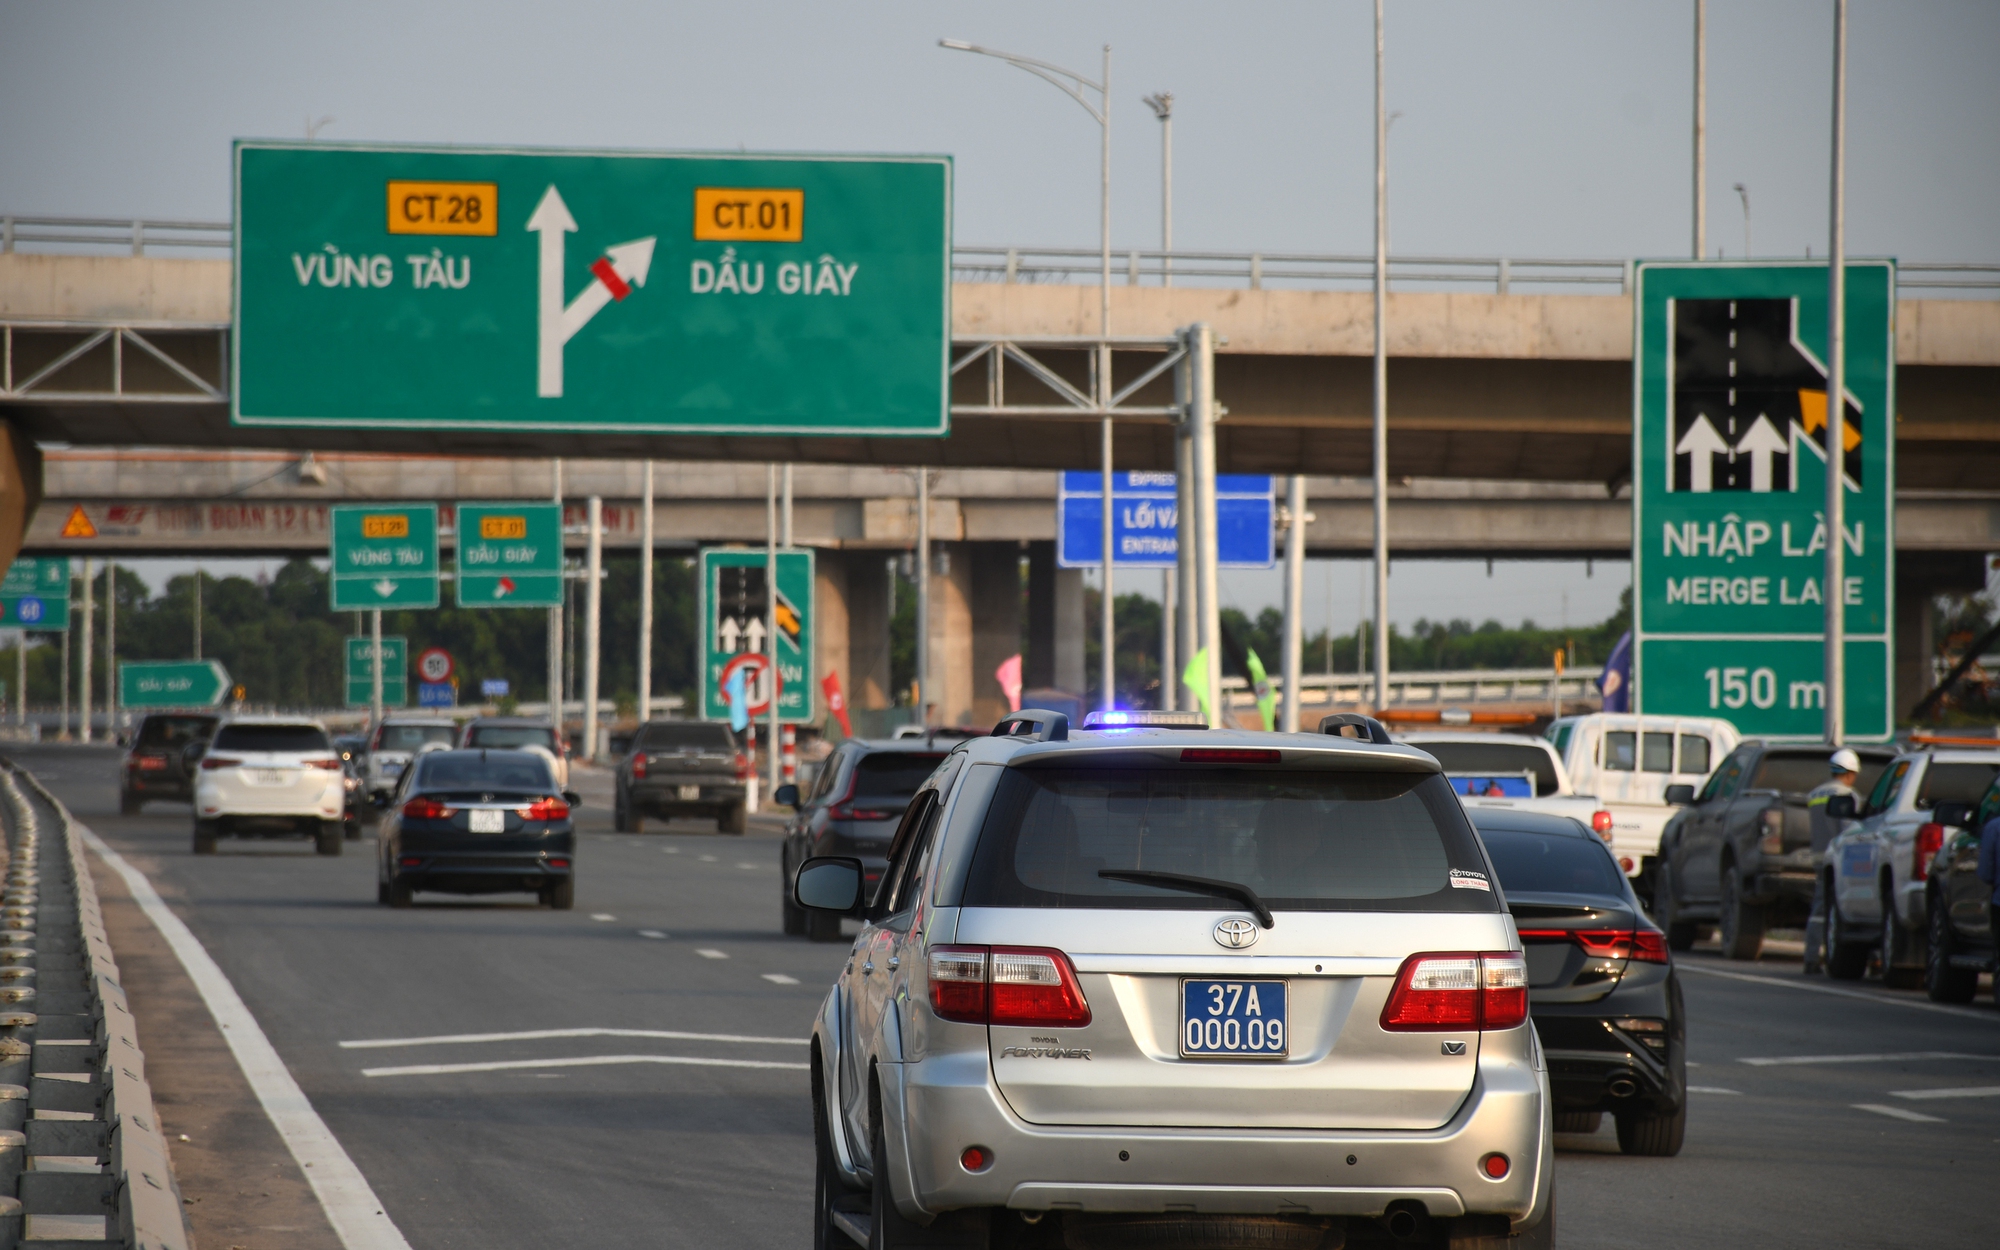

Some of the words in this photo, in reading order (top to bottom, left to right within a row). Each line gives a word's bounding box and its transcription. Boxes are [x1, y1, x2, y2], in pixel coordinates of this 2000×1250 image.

[403, 195, 483, 224] CT.28
[713, 200, 792, 231] CT.01
[291, 242, 394, 288] VŨNG
[405, 247, 472, 289] TÀU
[690, 245, 765, 294] DẦU
[777, 253, 859, 296] GIÂY
[1128, 471, 1179, 487] EXPRES
[1123, 500, 1155, 529] LỐI
[1121, 535, 1179, 554] ENTRAN
[1663, 512, 1772, 563] NHẬP
[1781, 511, 1864, 556] LÀN
[1666, 577, 1769, 605] MERGE
[1780, 577, 1864, 605] LAE
[1704, 667, 1777, 709] 150
[1789, 681, 1827, 709] m
[1461, 870, 1486, 880] TOYOTA
[1207, 984, 1262, 1016] 37A
[1031, 1036, 1060, 1044] TOYOTA
[1186, 1018, 1283, 1050] 000.09
[1001, 1046, 1092, 1060] FORTUNER
